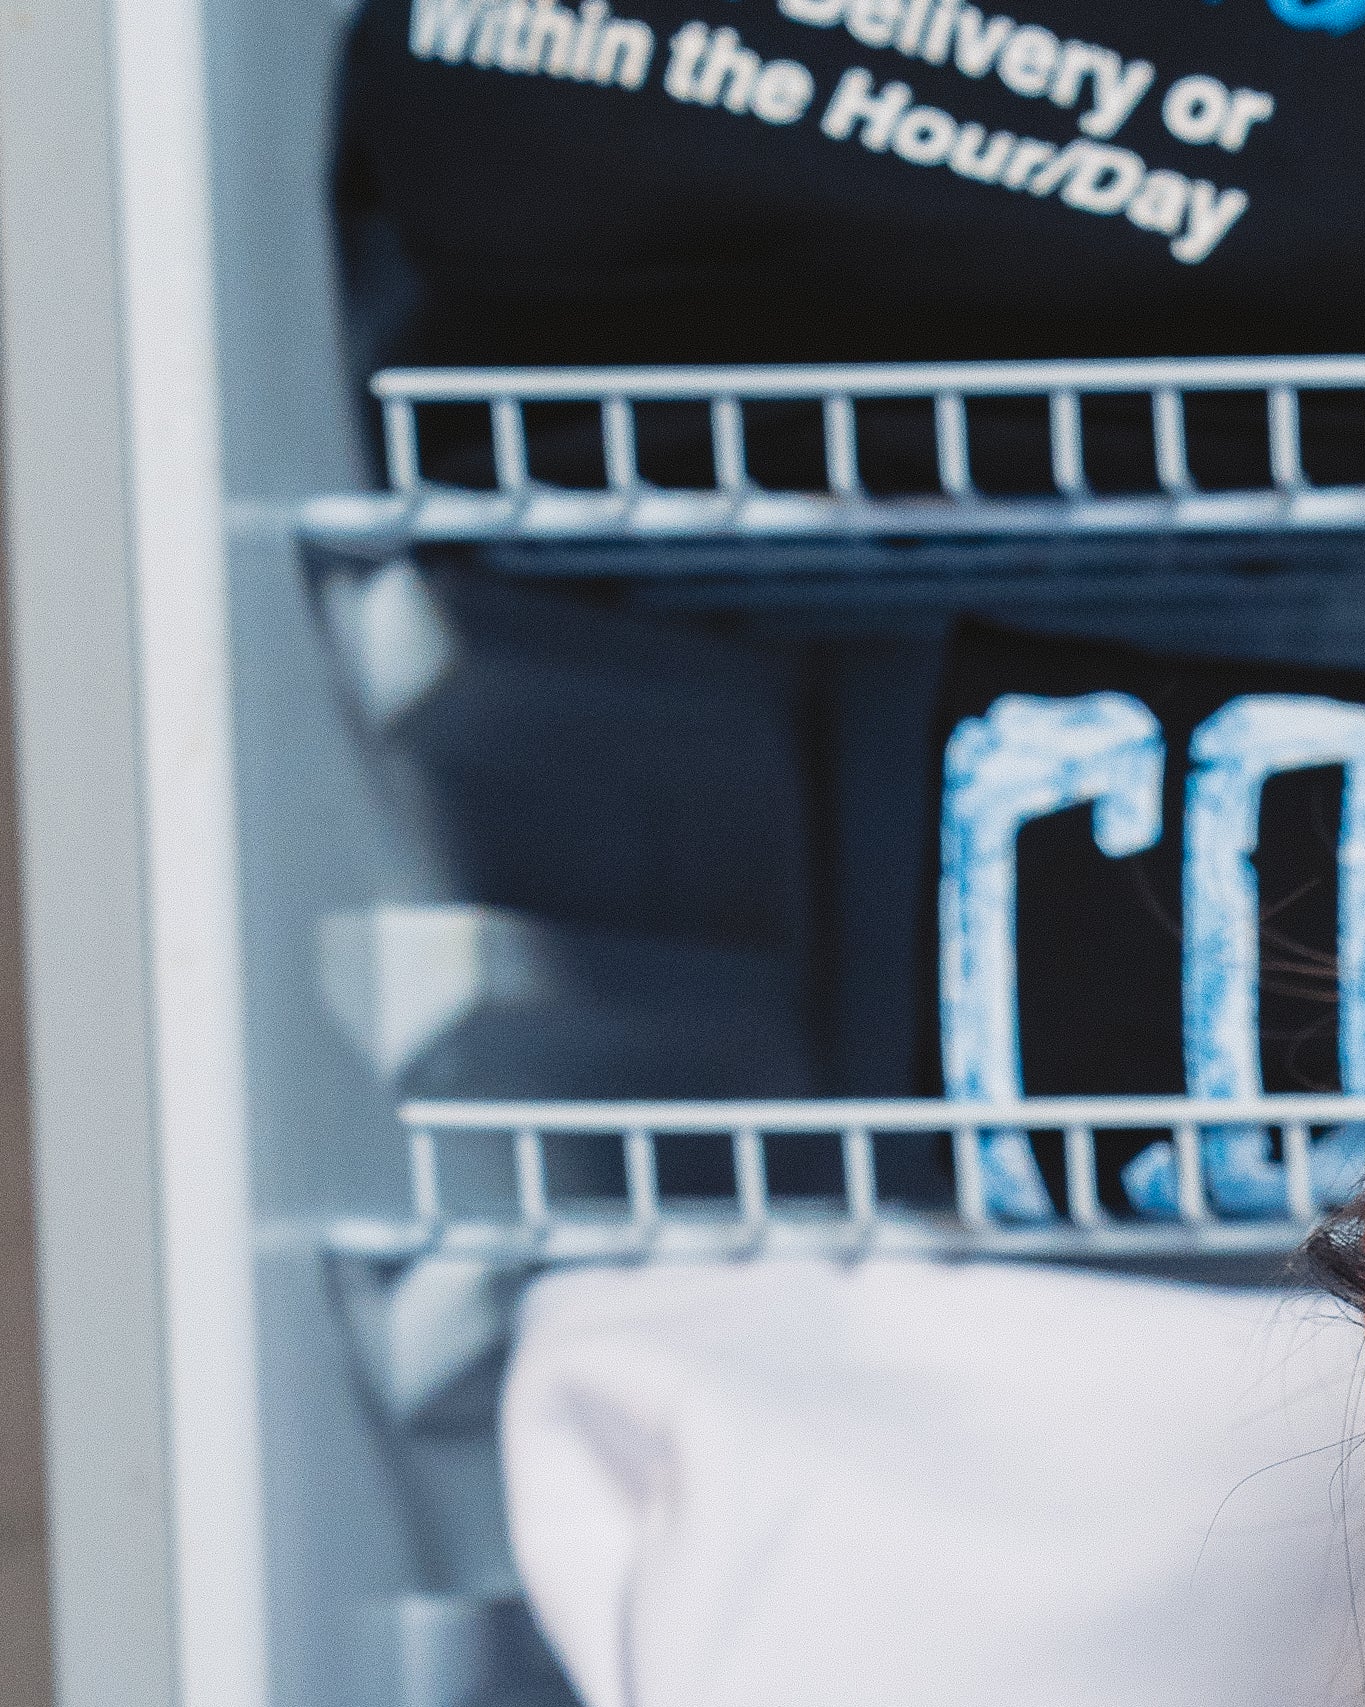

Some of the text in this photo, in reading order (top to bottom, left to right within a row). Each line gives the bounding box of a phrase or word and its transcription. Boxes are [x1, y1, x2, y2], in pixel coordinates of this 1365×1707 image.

[664, 20, 816, 126] the
[820, 66, 1248, 264] Hour/Day
[1162, 73, 1275, 152] or
